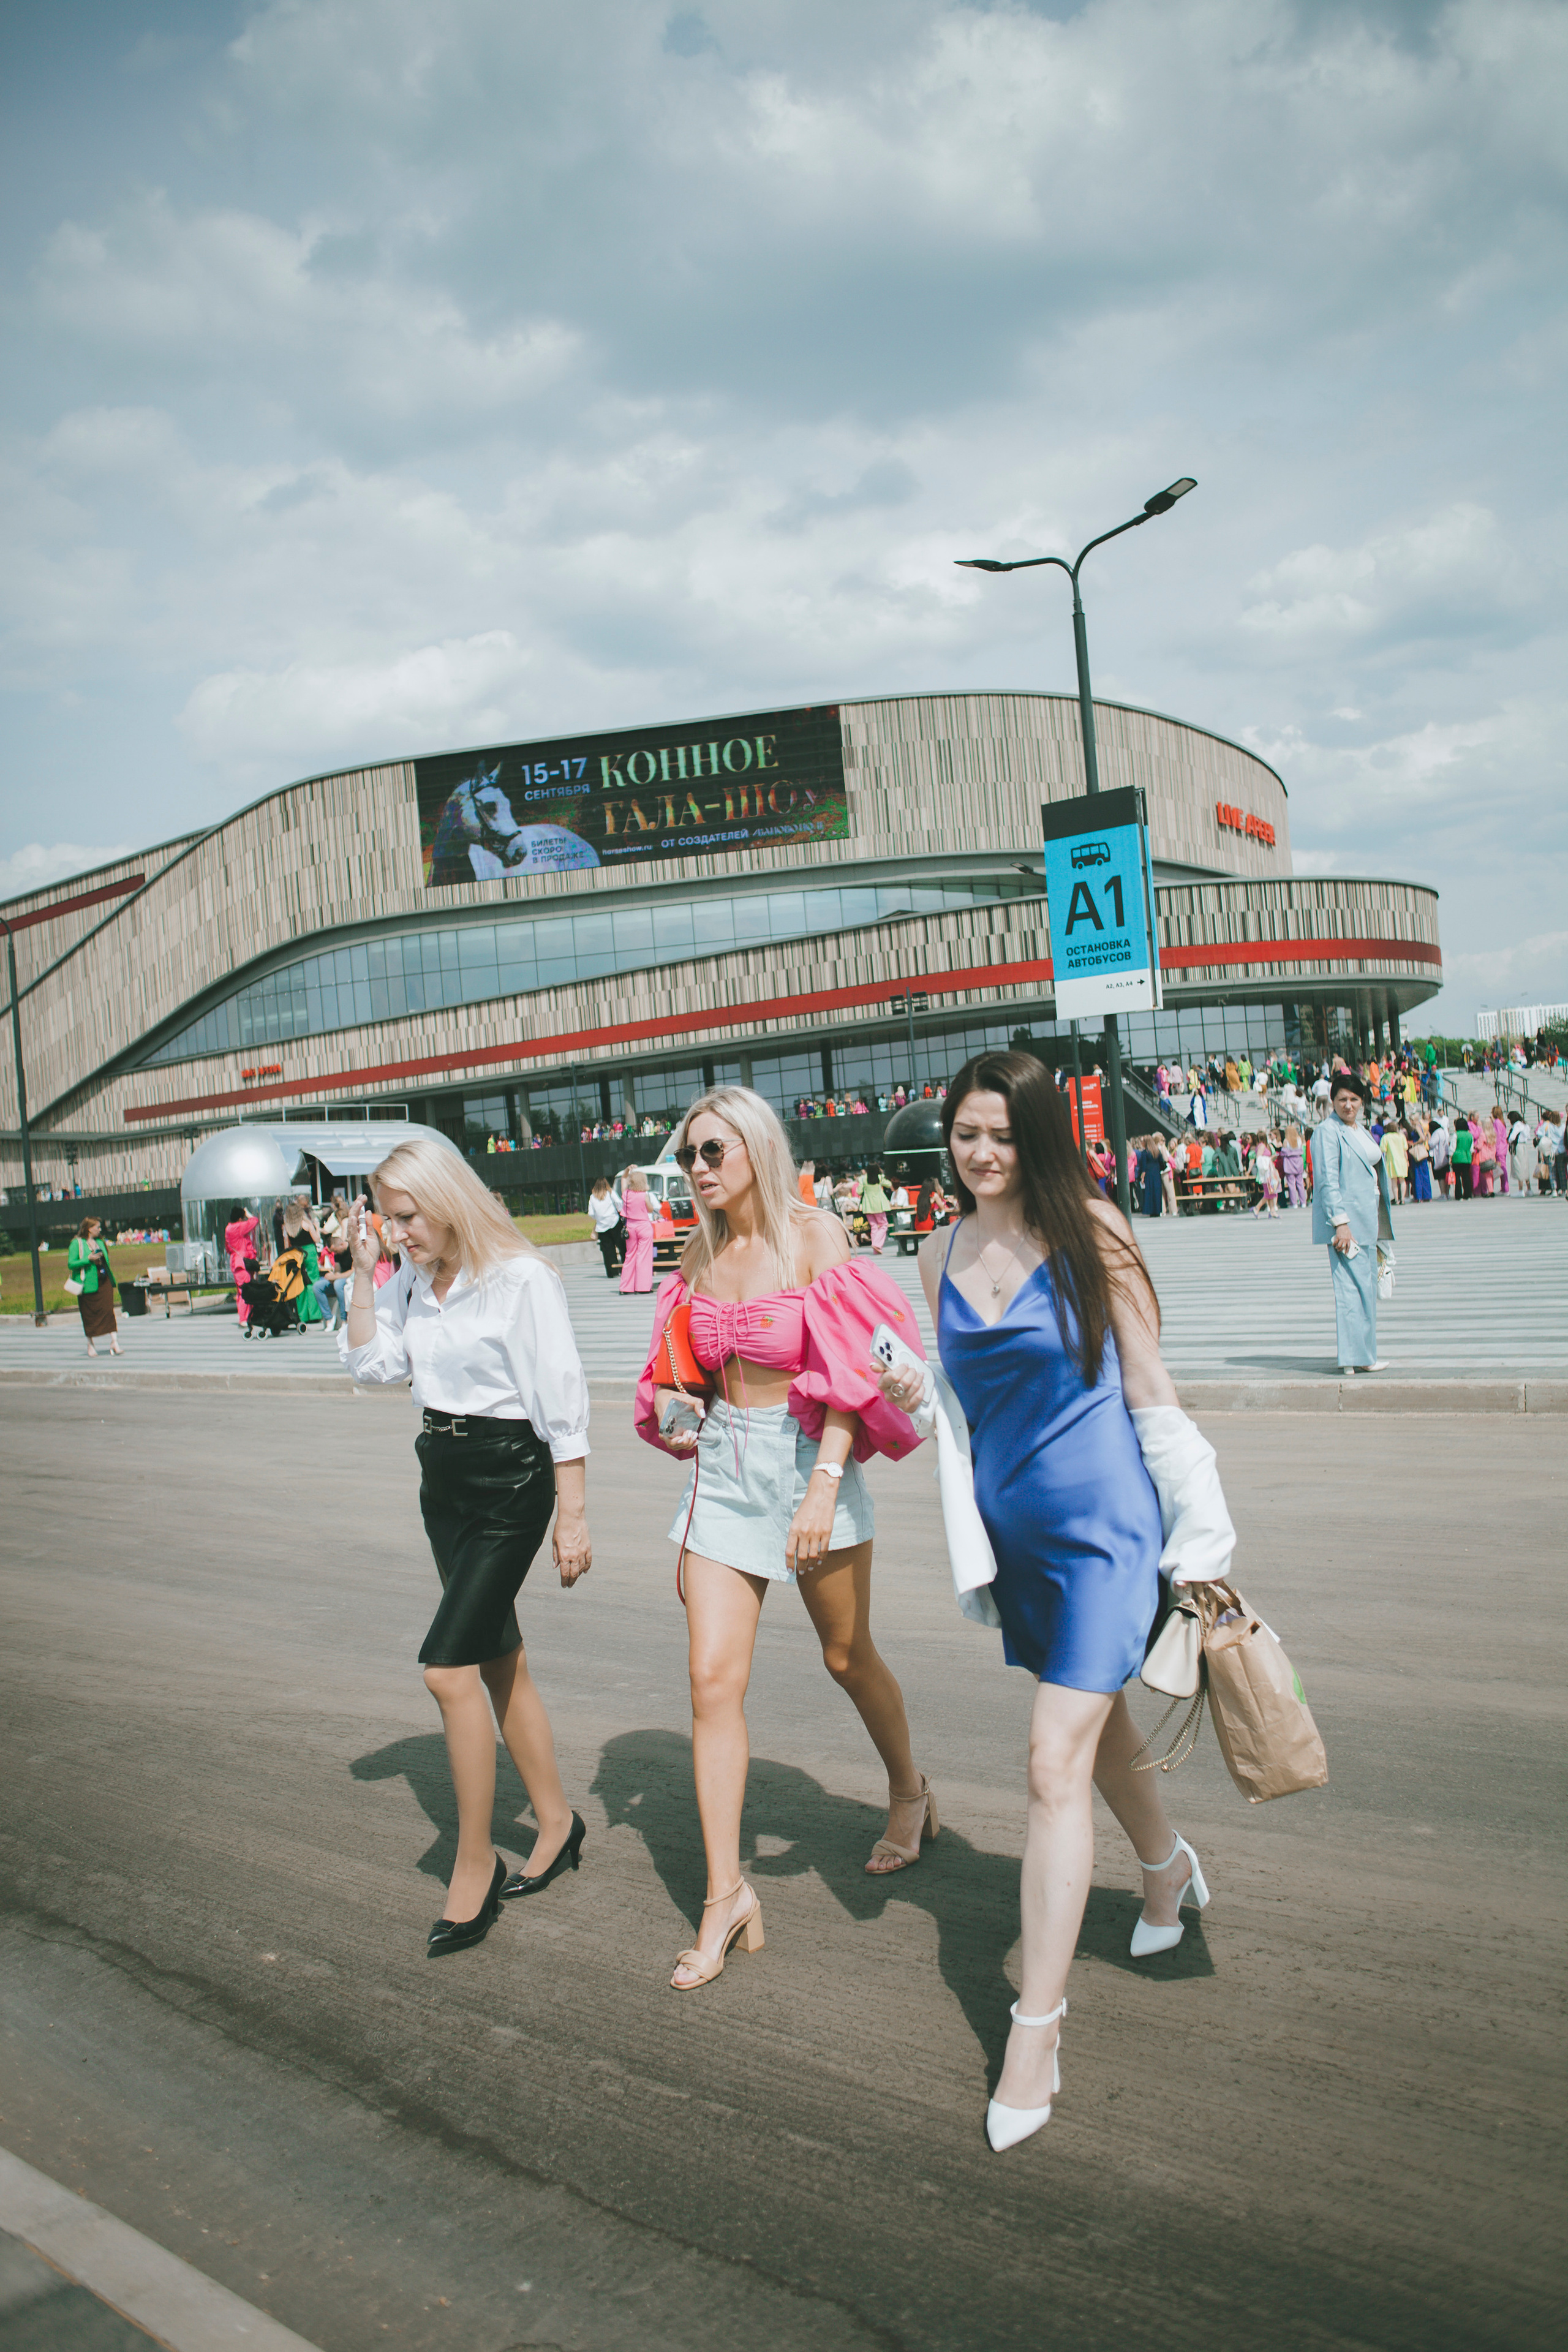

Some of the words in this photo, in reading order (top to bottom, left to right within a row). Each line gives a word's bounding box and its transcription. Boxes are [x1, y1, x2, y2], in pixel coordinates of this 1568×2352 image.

[521, 756, 587, 785] 15-17
[598, 734, 780, 789] КОННОЕ
[524, 783, 591, 802] СЕНТЯБРЯ
[1217, 801, 1246, 831] LIVE
[531, 837, 567, 848] БИЛЕТЫ
[661, 837, 676, 848] ОТ
[677, 828, 749, 846] СОЗДАТЕЛЕЙ
[532, 845, 562, 856] СКОРО
[541, 851, 584, 863] ПРОДАЖЕ
[602, 845, 652, 856] horseshow.ru
[1065, 875, 1125, 936] А1
[1066, 938, 1131, 956] ОСТАНОВКА
[1068, 951, 1132, 968] АВТОБУСОВ
